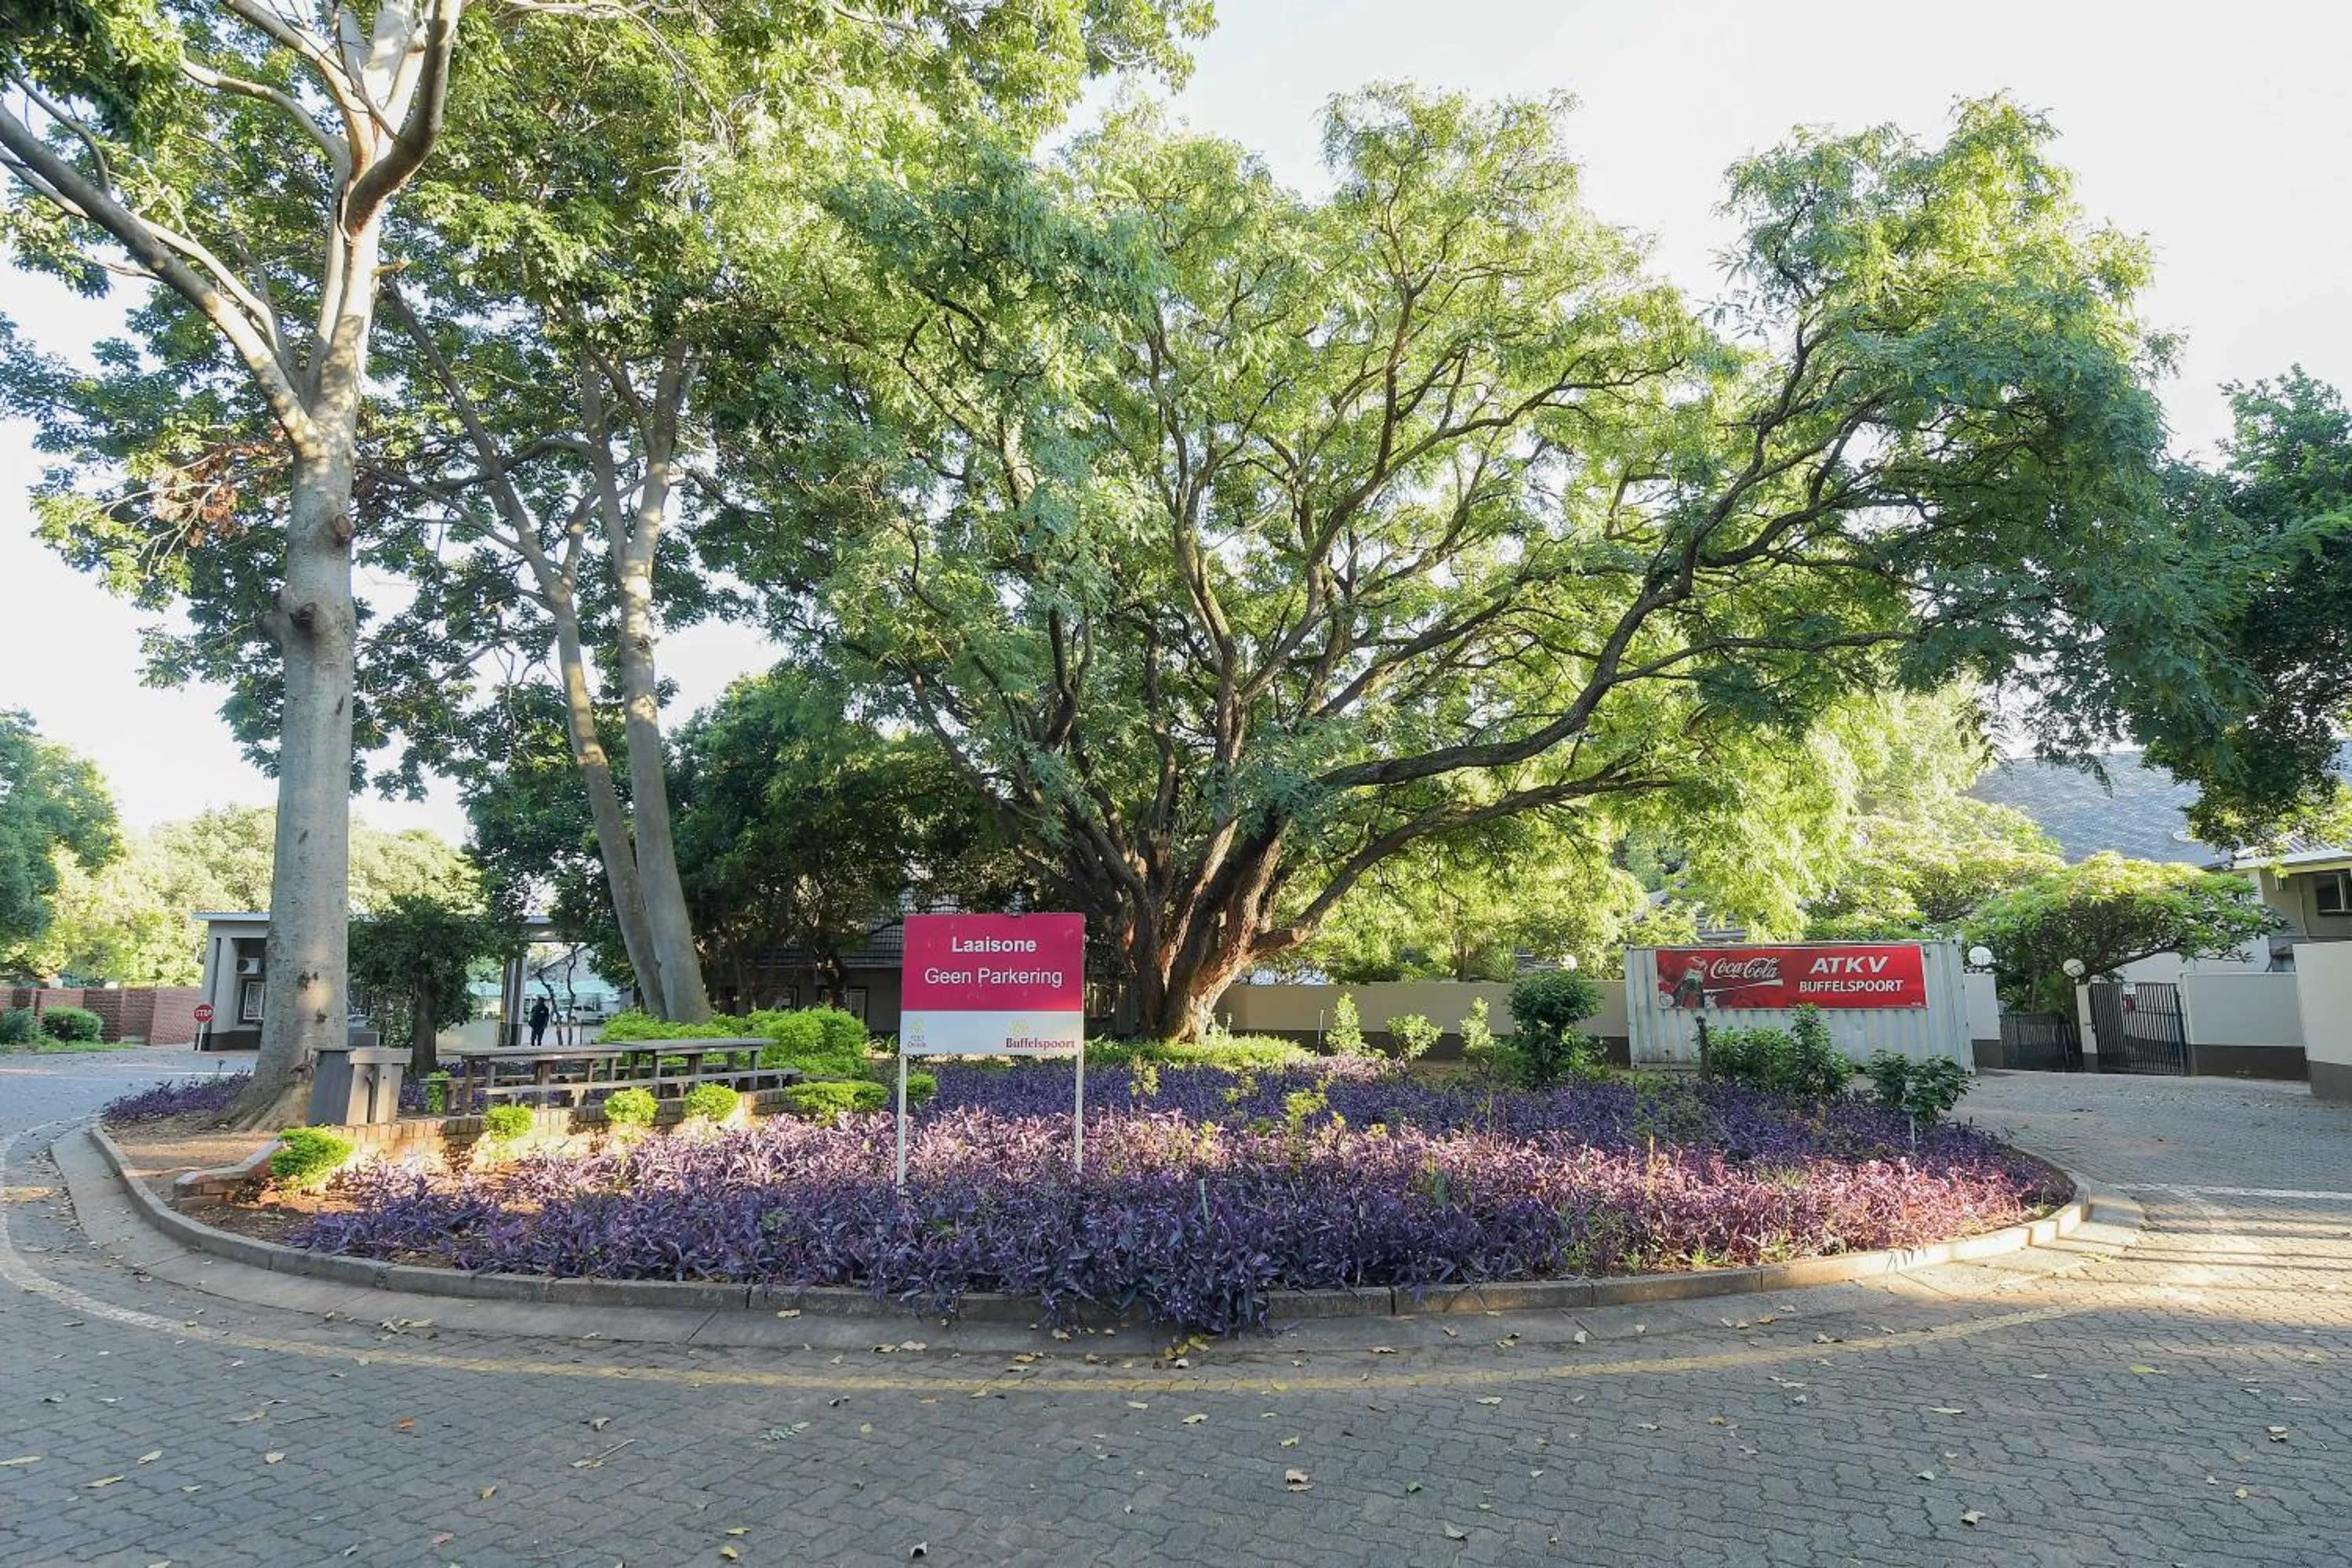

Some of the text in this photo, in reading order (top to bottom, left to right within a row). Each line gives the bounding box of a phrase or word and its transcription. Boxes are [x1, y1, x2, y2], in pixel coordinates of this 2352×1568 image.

[952, 936, 1037, 953] Laaisone
[1710, 957, 1780, 979] Coca-Cola
[1809, 956, 1889, 975] ATKV
[924, 967, 1062, 988] Geen Parkering
[1799, 980, 1904, 993] BUFFELSPOORT
[1006, 1037, 1075, 1051] Buffelspoort
